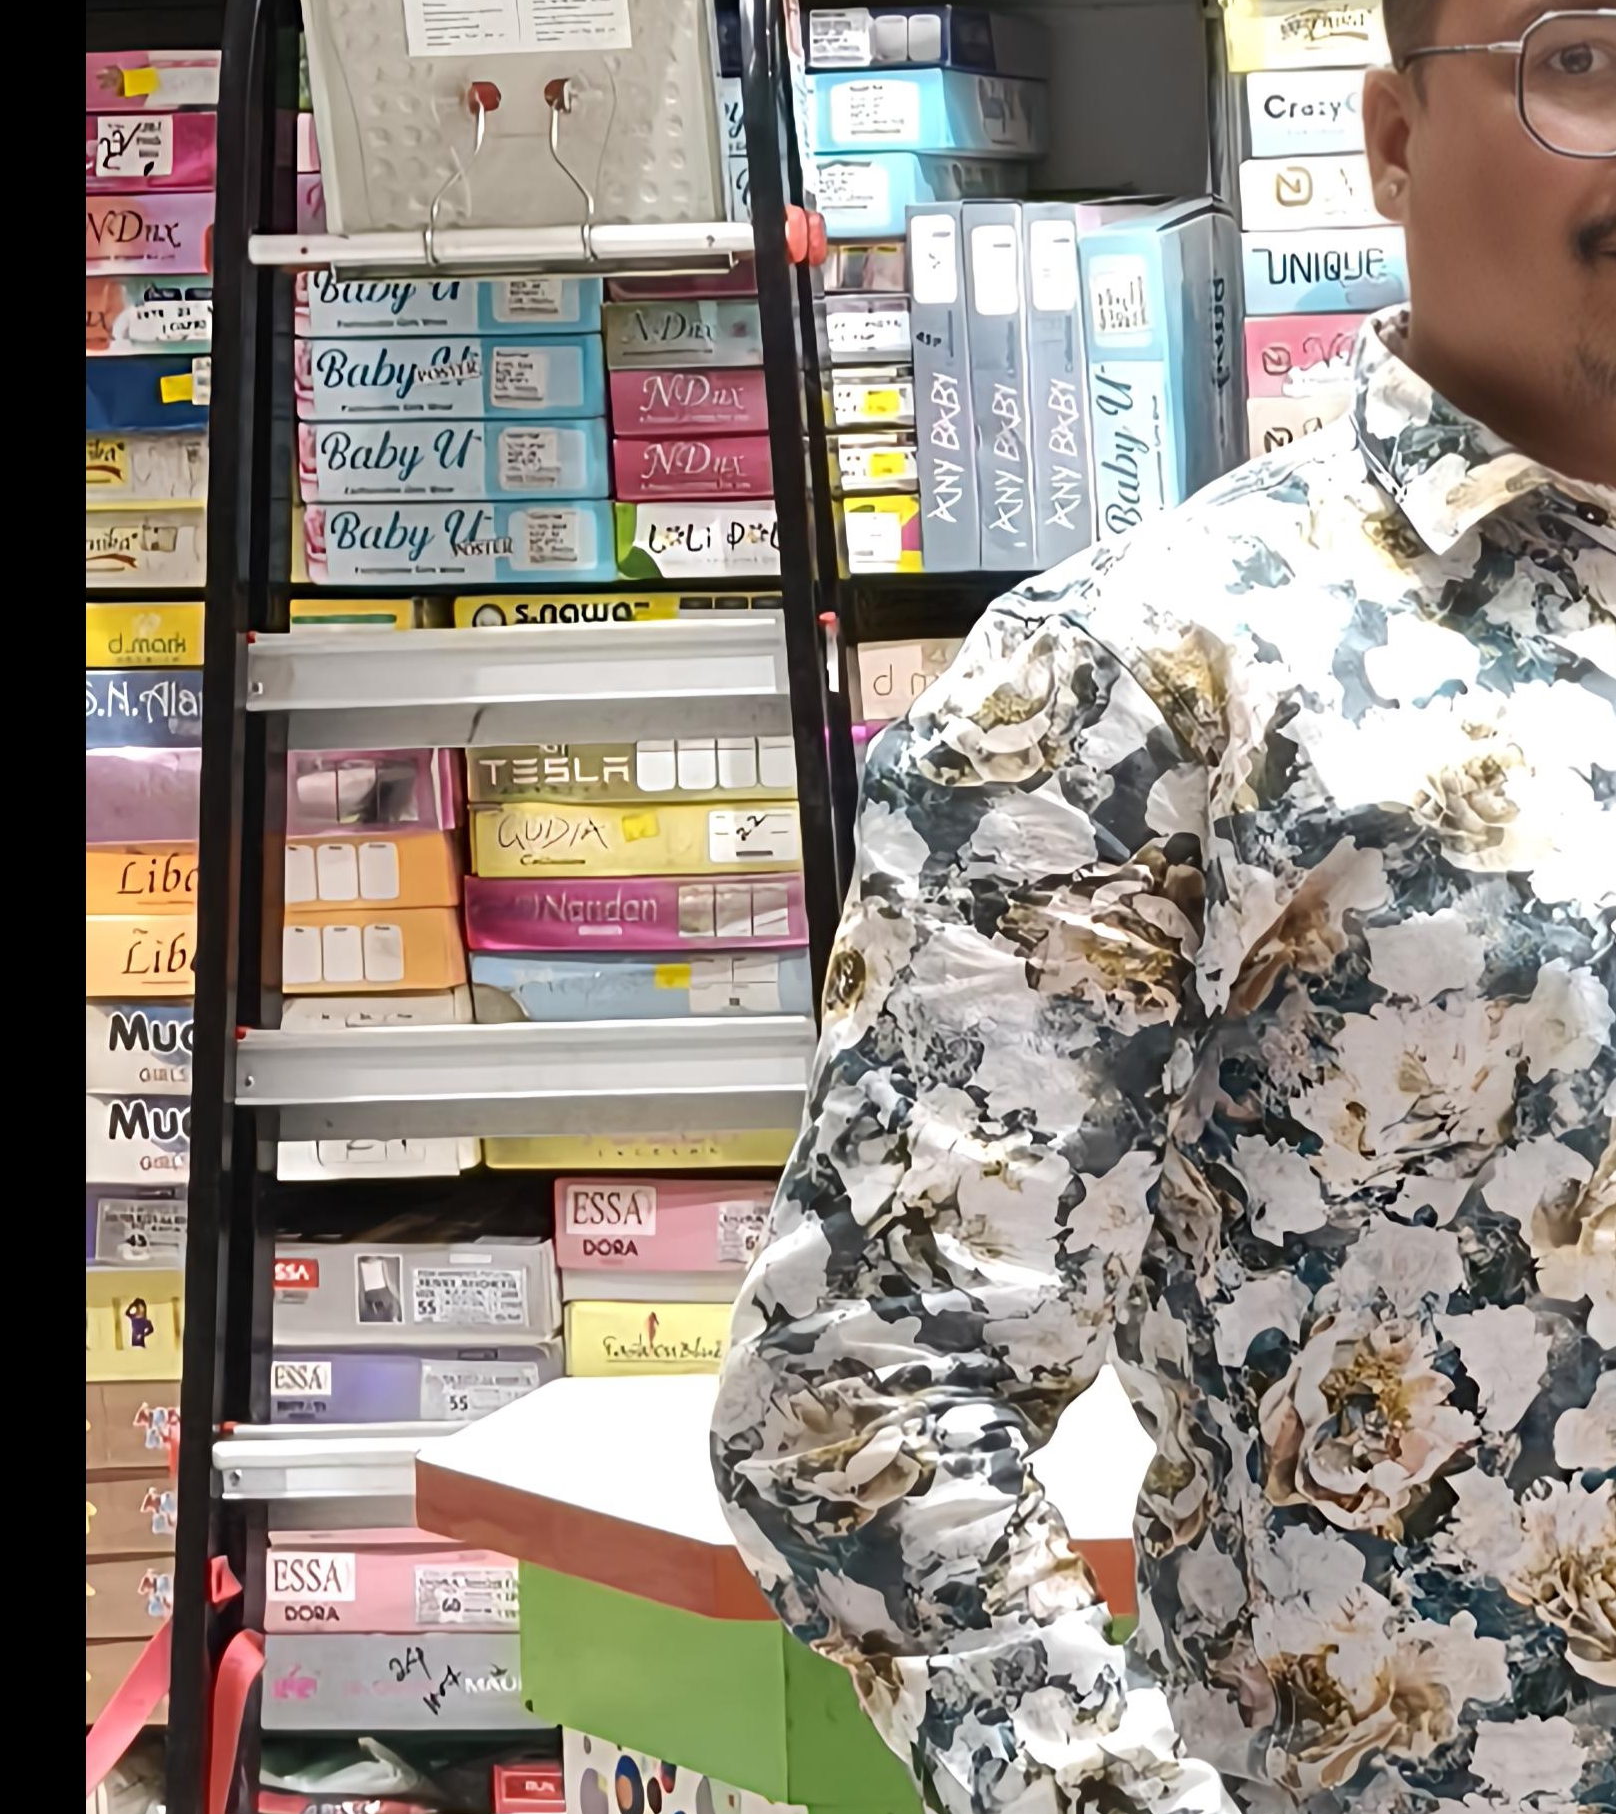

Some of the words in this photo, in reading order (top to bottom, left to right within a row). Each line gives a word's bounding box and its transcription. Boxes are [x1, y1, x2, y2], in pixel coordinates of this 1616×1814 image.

[1252, 248, 1385, 285] UNIQUE
[317, 348, 417, 398] Baby
[321, 430, 424, 481] Baby
[434, 429, 475, 469] U
[1105, 425, 1152, 536] Baby
[330, 510, 435, 561] Baby
[444, 509, 484, 545] U
[515, 601, 651, 623] s.nawa
[86, 679, 203, 723] .N.Ala
[479, 757, 629, 785] TESLA
[121, 931, 195, 975] Lib
[572, 1191, 645, 1226] ESSA
[582, 1238, 639, 1257] DORA
[275, 1262, 310, 1281] SSA
[275, 1363, 325, 1390] ESSA
[273, 1558, 344, 1593] ESSA
[284, 1606, 340, 1622] DORA
